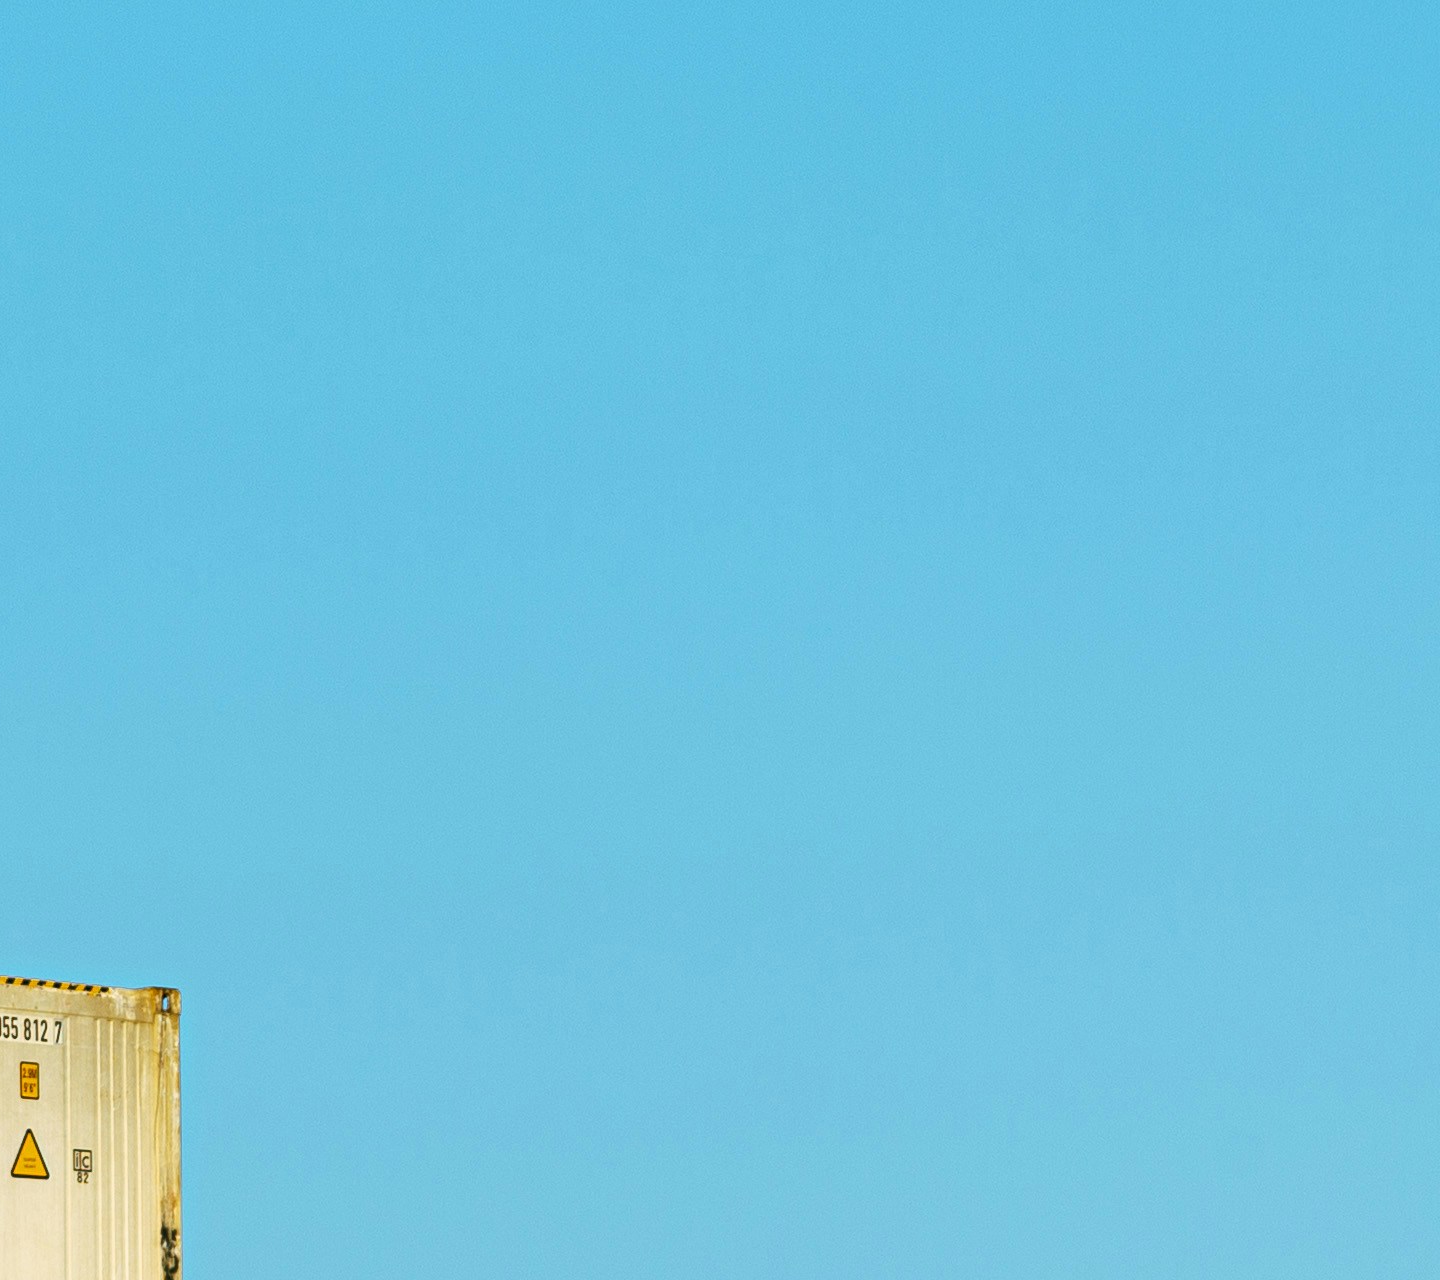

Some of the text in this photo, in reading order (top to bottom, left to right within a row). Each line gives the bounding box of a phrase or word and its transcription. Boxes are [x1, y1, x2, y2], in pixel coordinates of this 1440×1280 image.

[23, 1018, 49, 1043] 812
[54, 1021, 63, 1044] 7
[76, 1172, 89, 1184] 82
